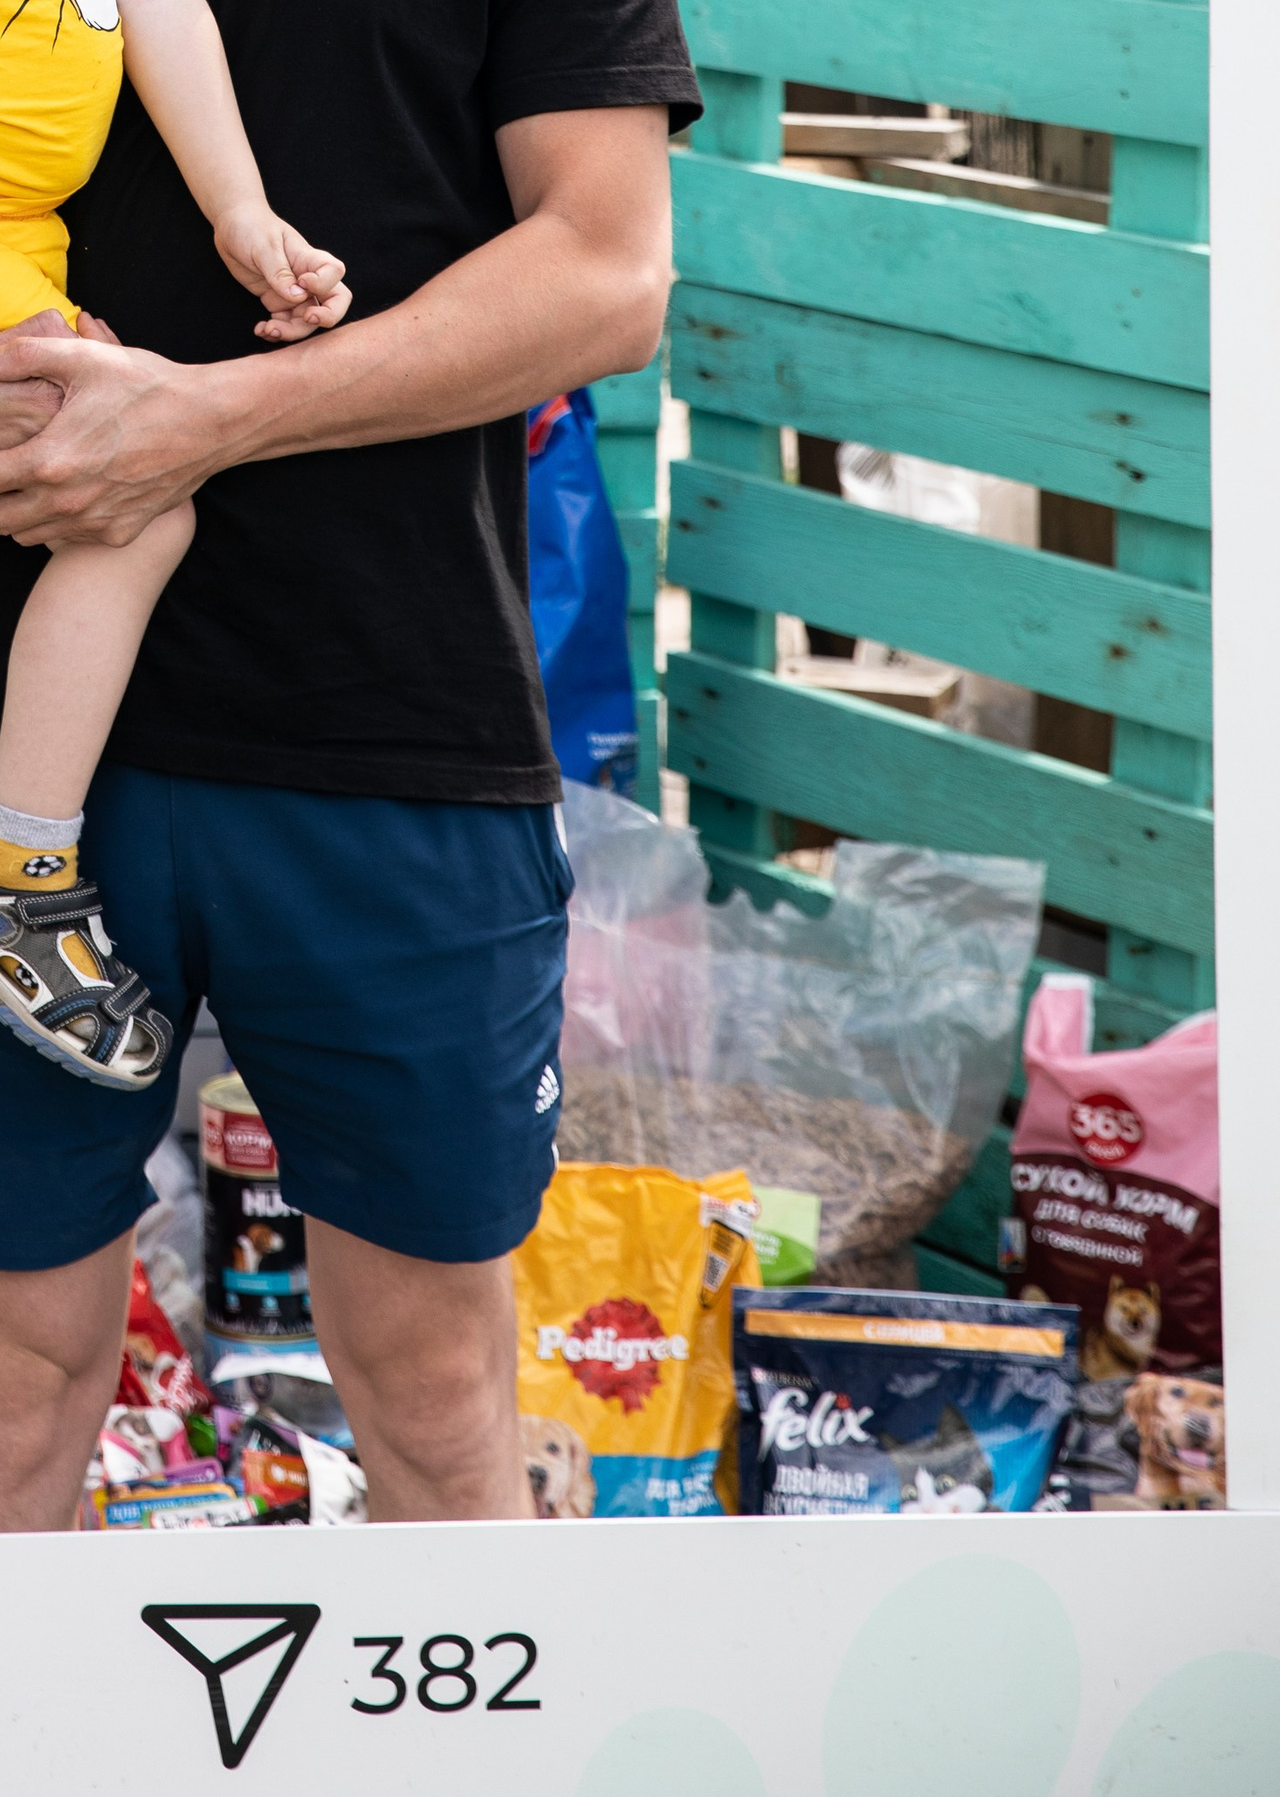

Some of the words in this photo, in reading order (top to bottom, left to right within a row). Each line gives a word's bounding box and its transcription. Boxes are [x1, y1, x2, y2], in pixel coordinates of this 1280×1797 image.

[1070, 1103, 1143, 1144] 365
[1010, 1162, 1110, 1206] СУХОЙ
[1112, 1184, 1200, 1236] КОРМ
[1033, 1198, 1082, 1226] ДЛЯ
[536, 1325, 690, 1372] Pedigree
[349, 1631, 543, 1716] 382
